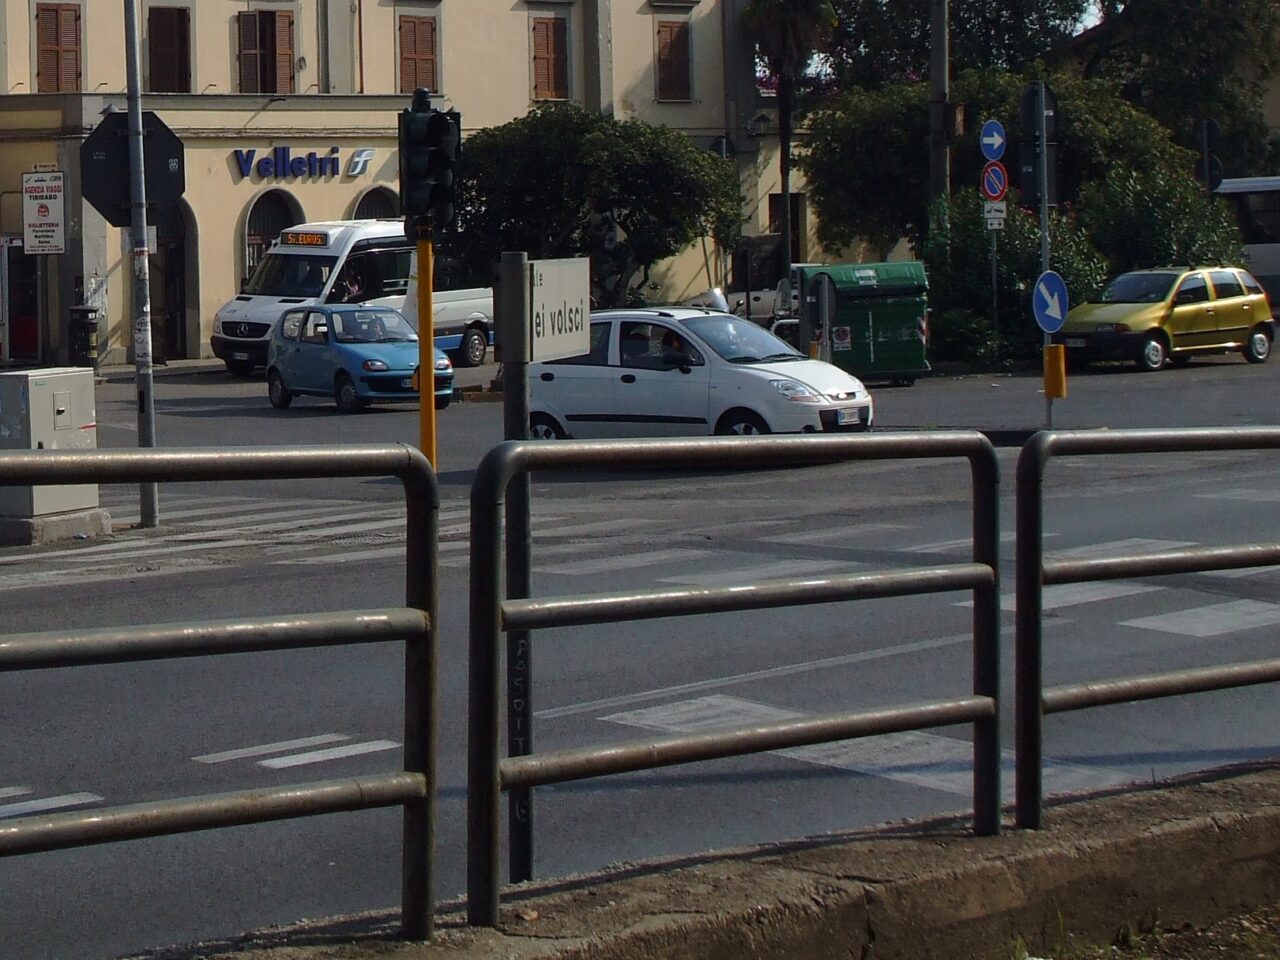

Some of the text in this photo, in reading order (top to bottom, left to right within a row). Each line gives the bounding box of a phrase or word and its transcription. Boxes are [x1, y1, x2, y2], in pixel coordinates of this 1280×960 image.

[234, 147, 339, 178] Velletri
[533, 268, 543, 287] le
[550, 298, 583, 336] volsci
